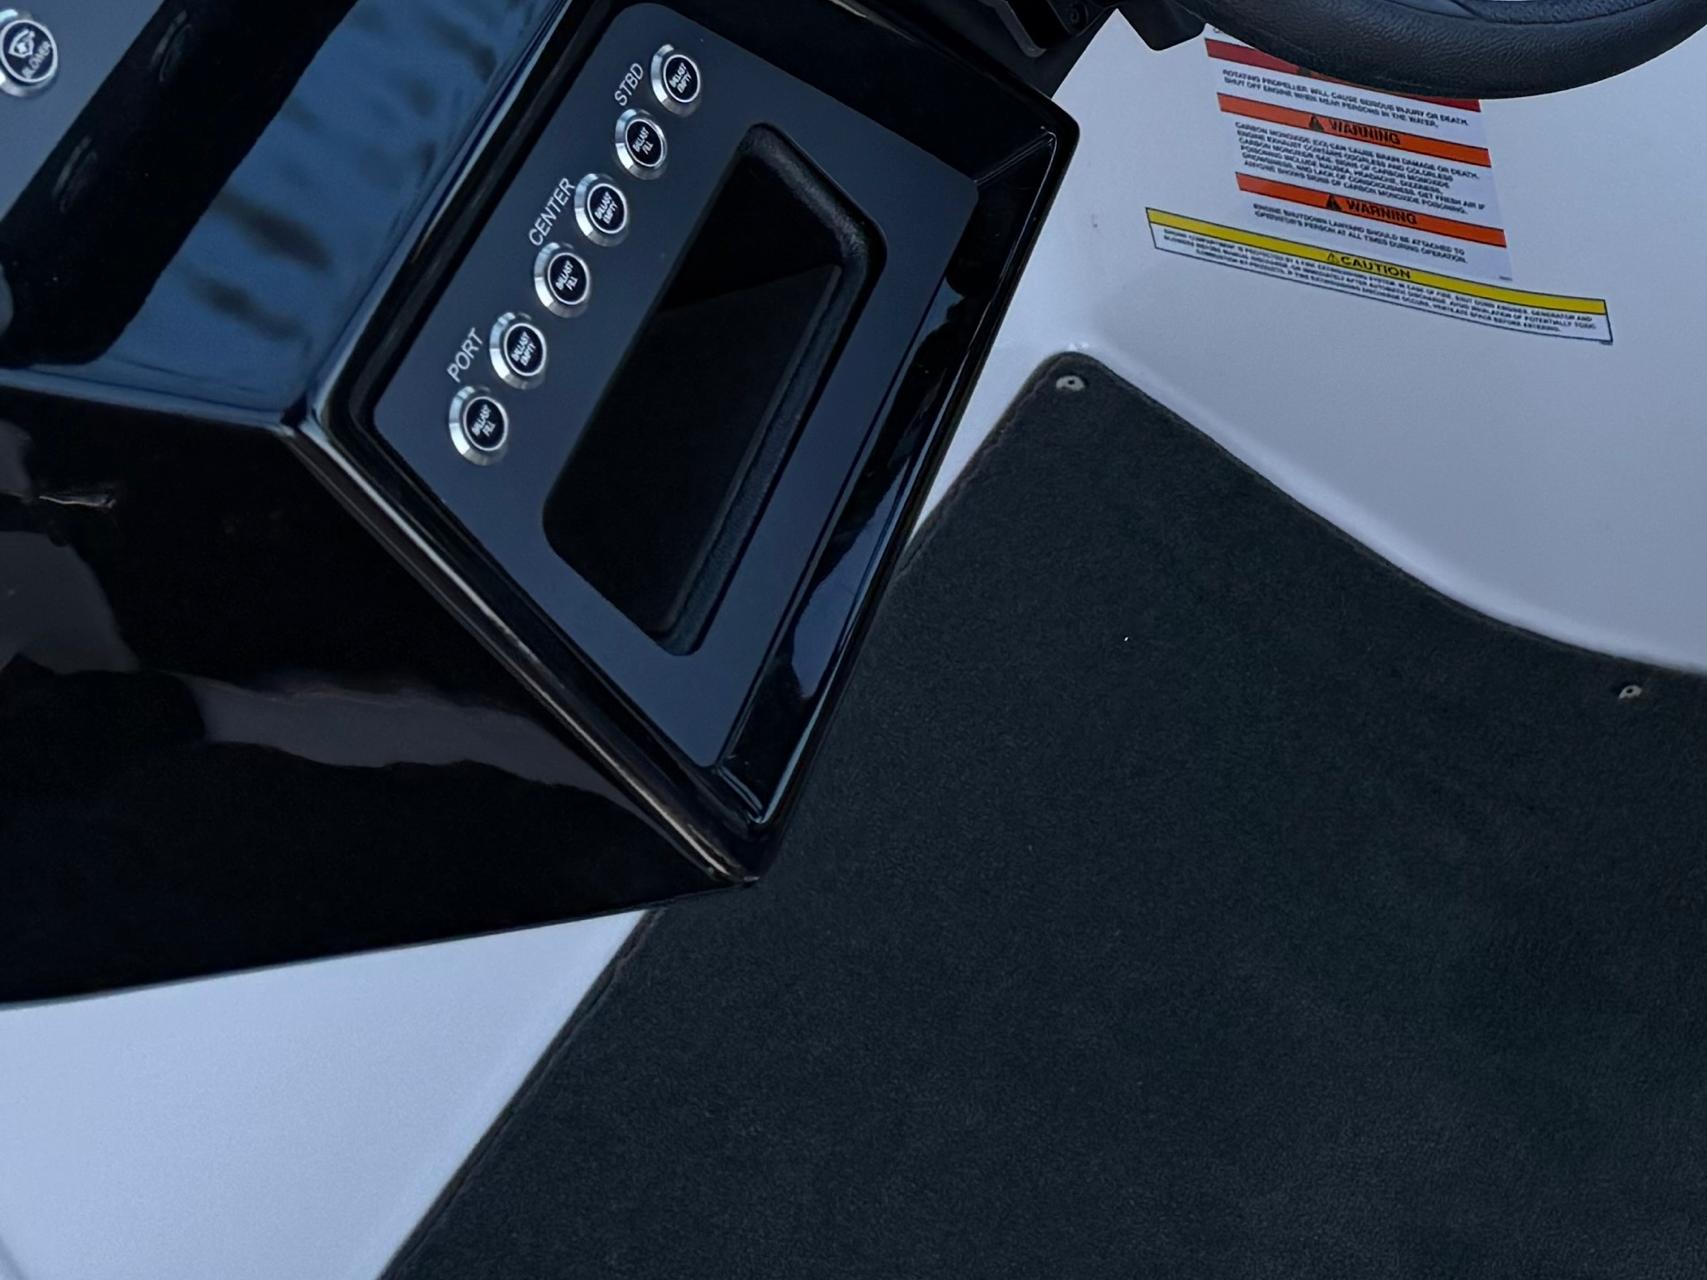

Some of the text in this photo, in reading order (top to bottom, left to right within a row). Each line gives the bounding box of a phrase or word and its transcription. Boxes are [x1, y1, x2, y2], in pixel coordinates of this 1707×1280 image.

[614, 63, 644, 106] STBD
[1328, 118, 1400, 144] WARNING
[529, 178, 575, 245] CENTER
[1346, 199, 1416, 225] WARNING
[1340, 255, 1411, 279] CAUTION
[446, 327, 483, 383] PORT
